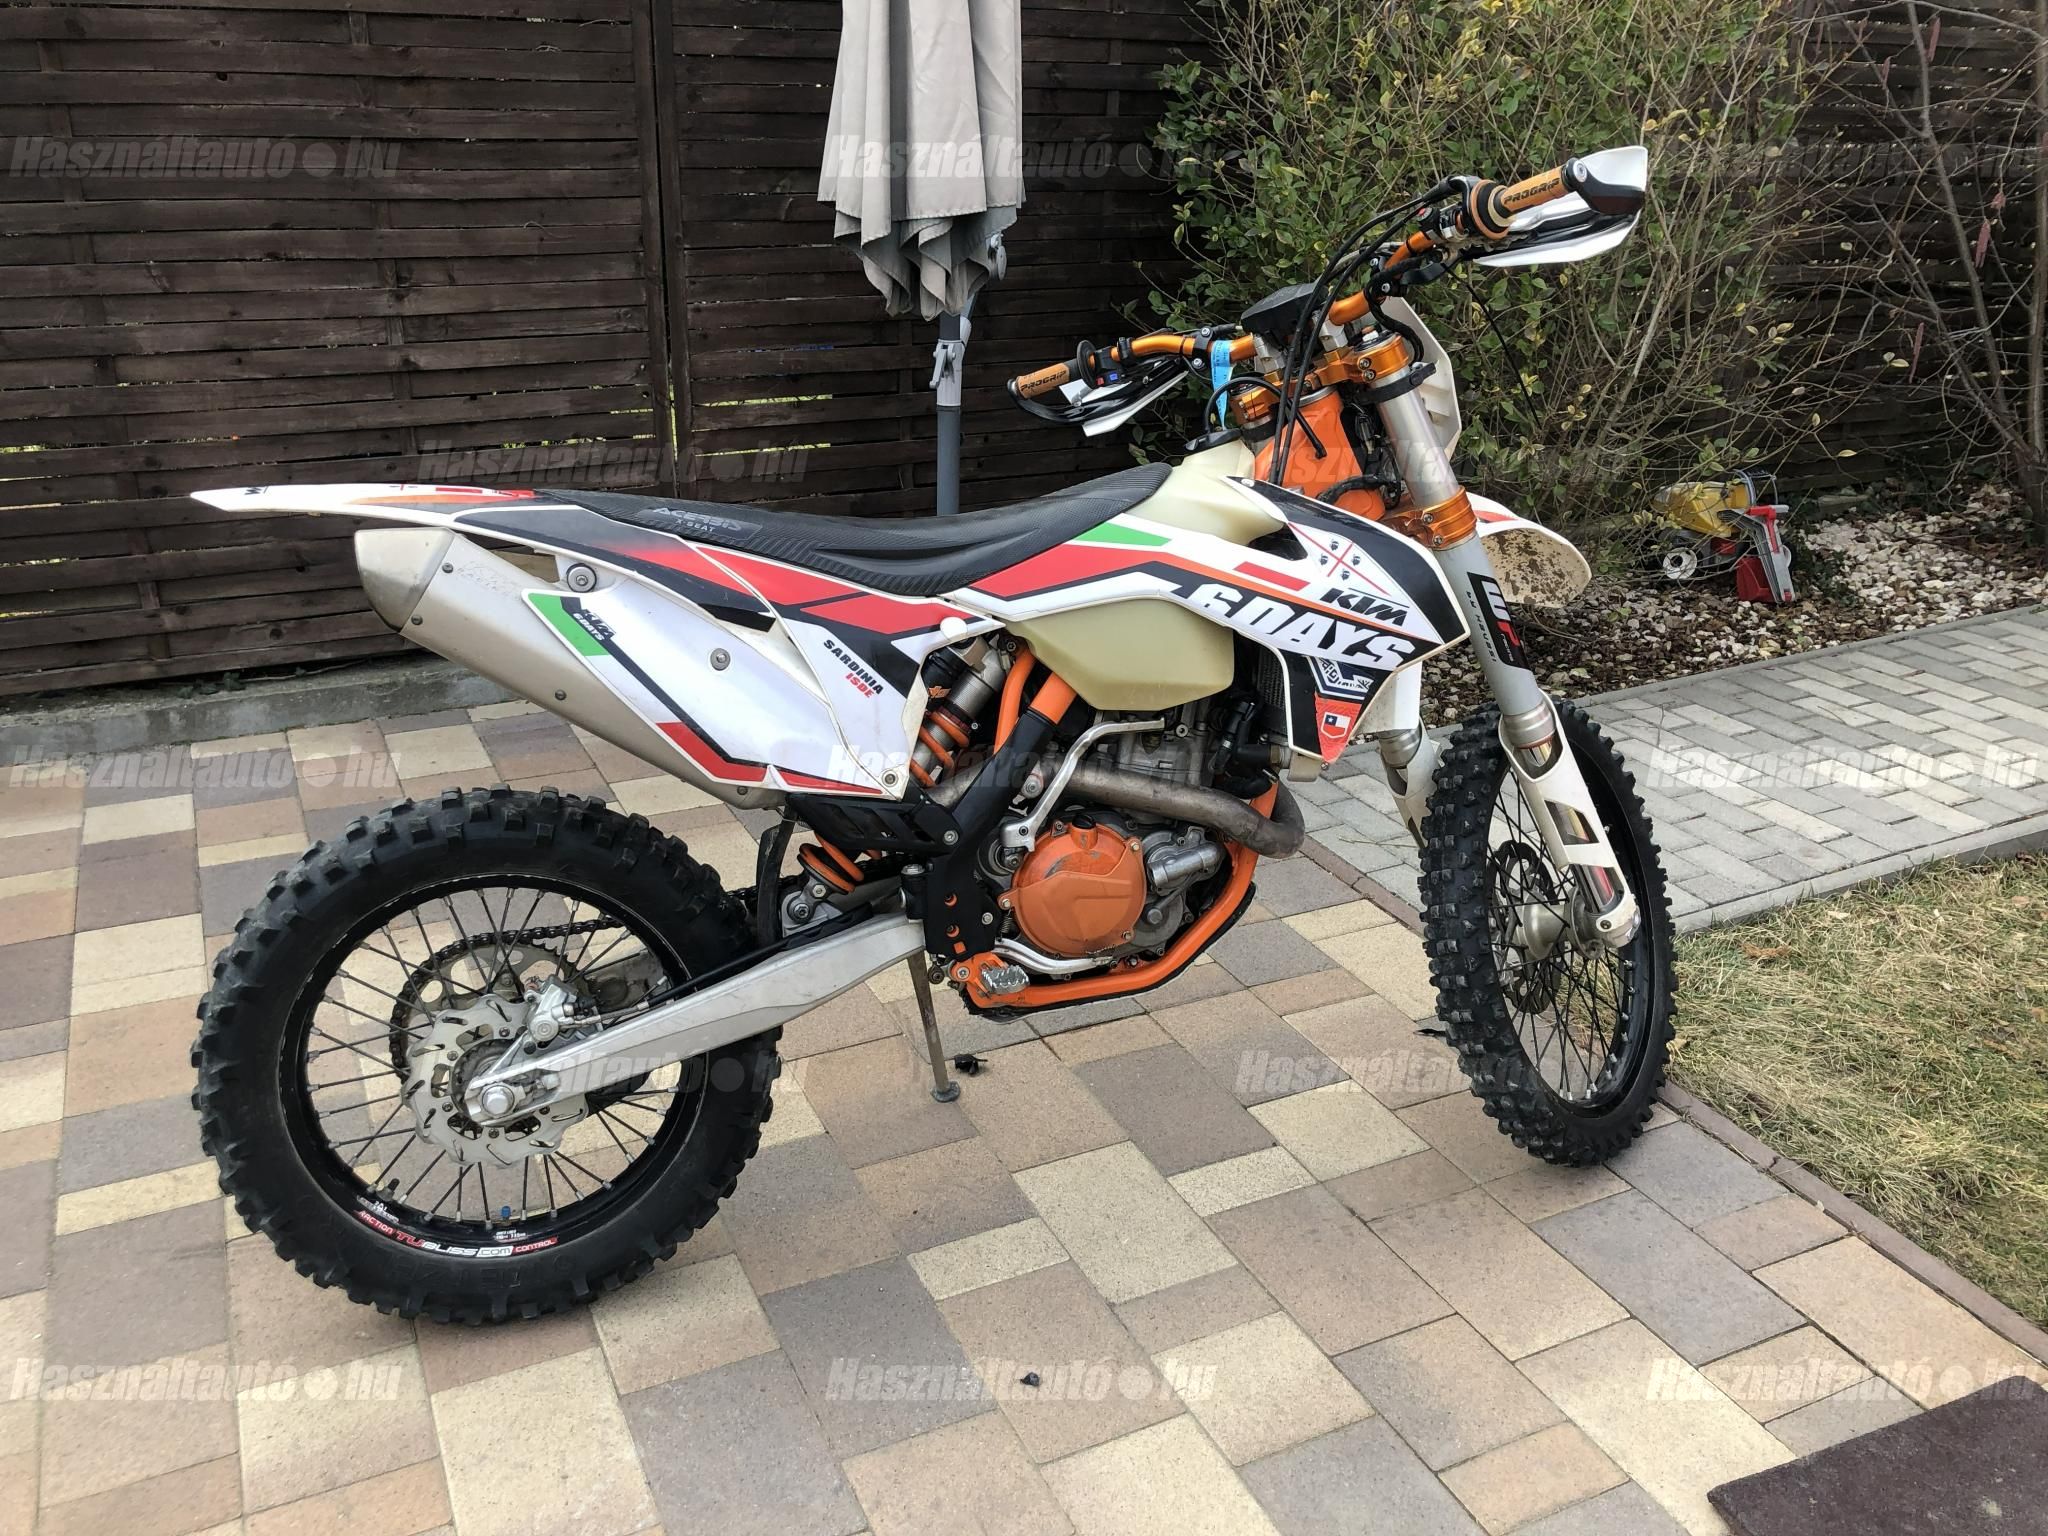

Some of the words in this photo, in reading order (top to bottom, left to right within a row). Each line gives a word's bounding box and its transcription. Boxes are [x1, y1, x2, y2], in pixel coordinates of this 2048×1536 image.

[1503, 177, 1560, 205] PROGRIP
[1020, 370, 1067, 391] PROGRIP
[1320, 588, 1410, 627] KTM
[1187, 583, 1416, 670] 6DAYS
[823, 639, 884, 695] SARDINIA
[845, 672, 875, 698] ISDE
[515, 1239, 557, 1253] CONTROL
